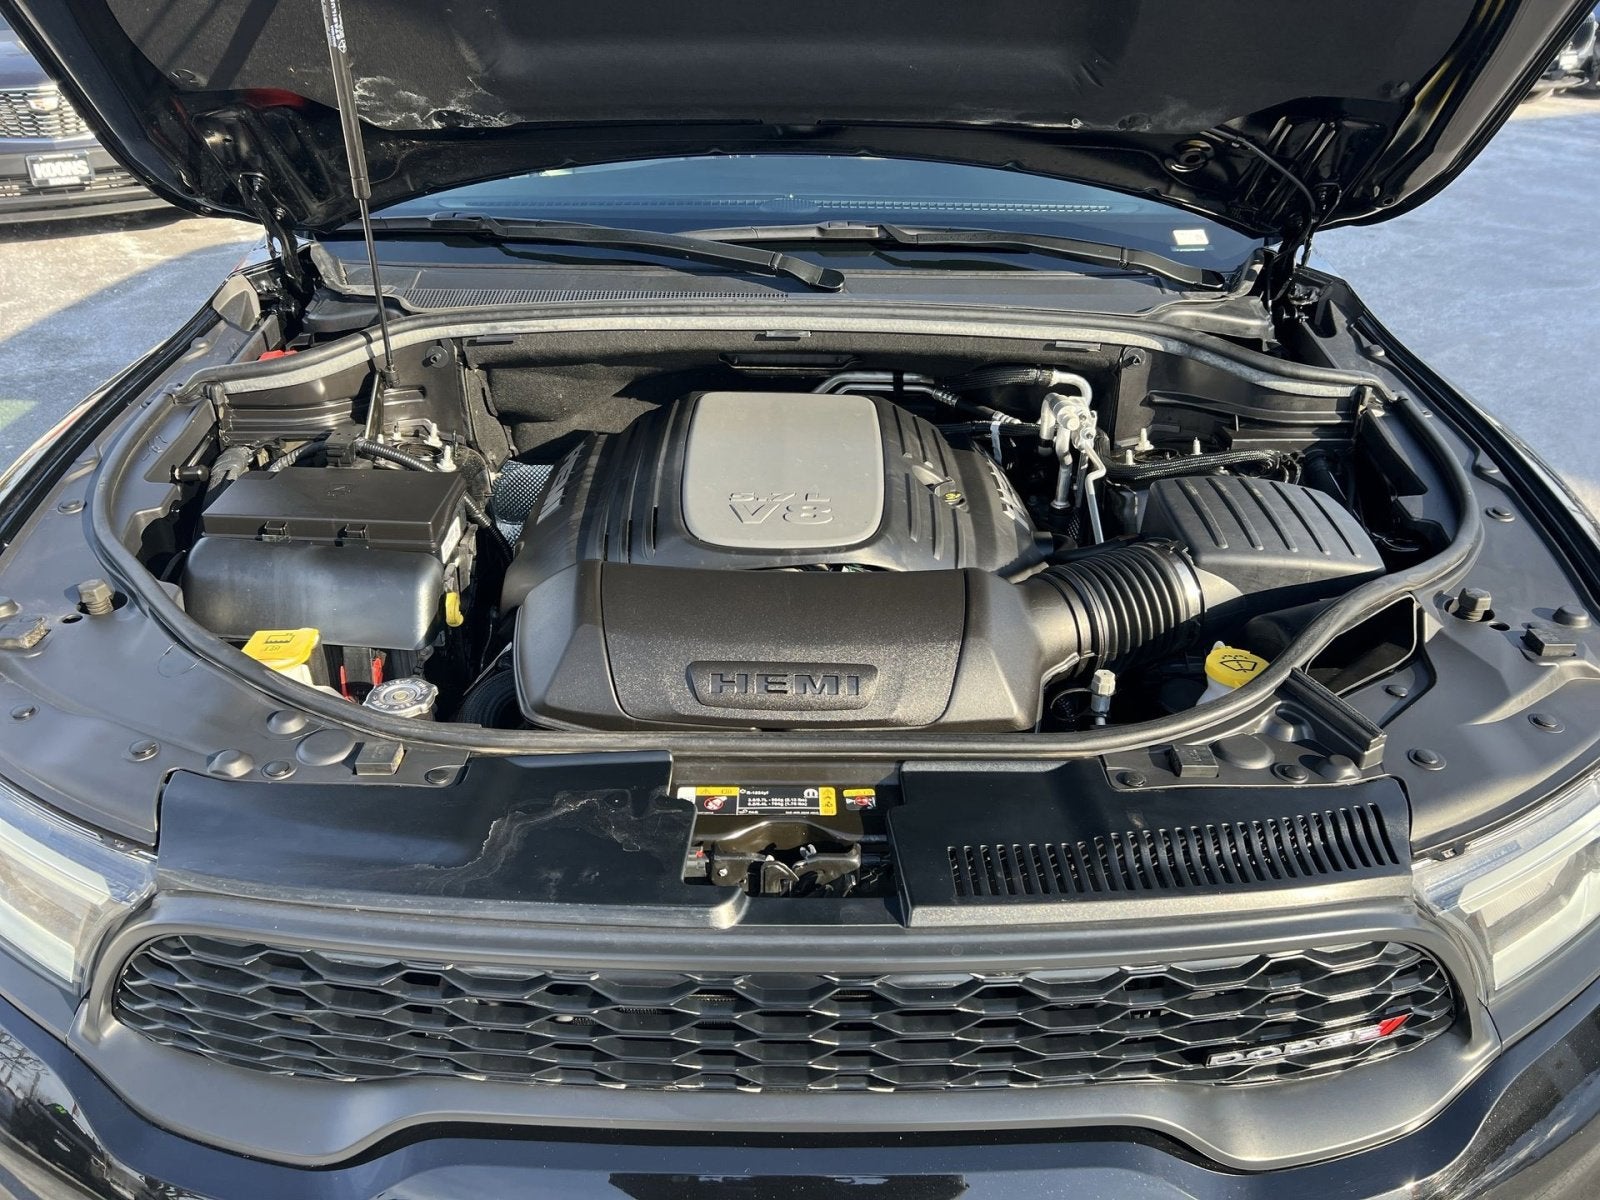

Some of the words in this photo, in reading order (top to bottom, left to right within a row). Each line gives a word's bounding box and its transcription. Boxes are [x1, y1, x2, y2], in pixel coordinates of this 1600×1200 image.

[33, 160, 89, 178] KOONS
[729, 503, 834, 525] V8
[709, 673, 860, 696] HEMI
[1206, 1024, 1383, 1068] DODGE
